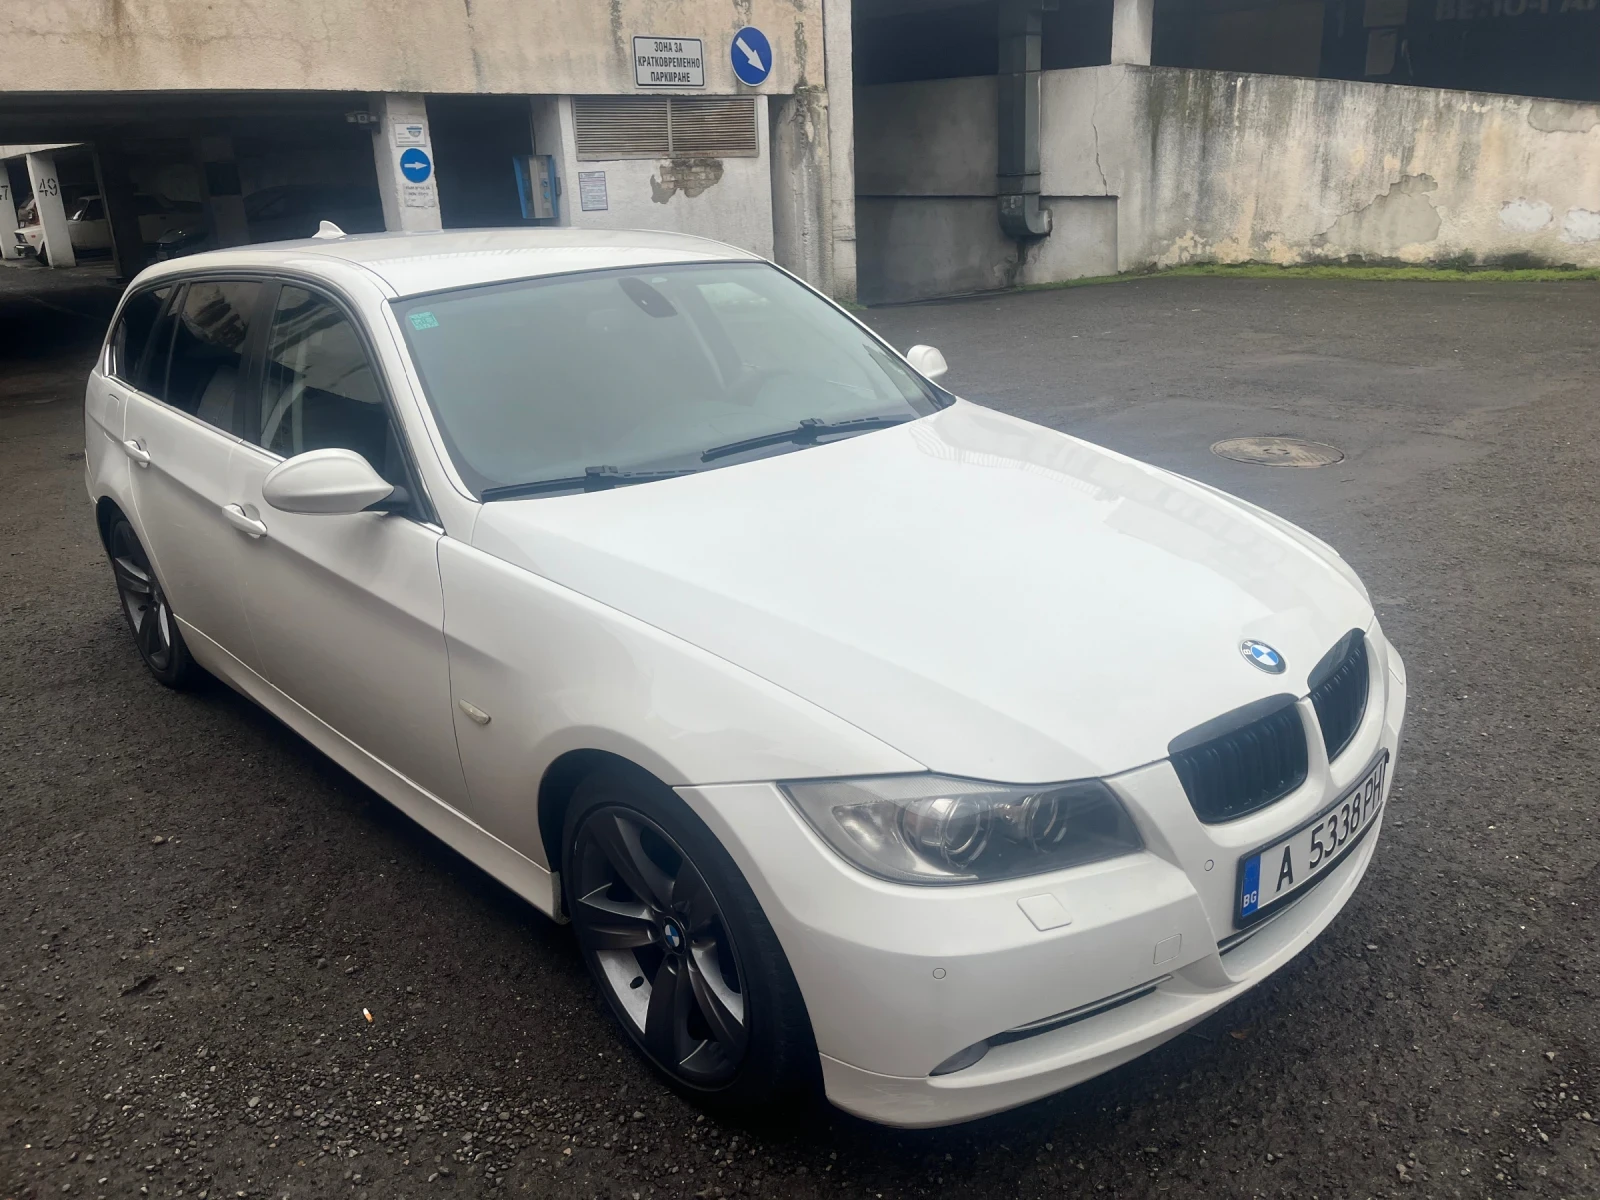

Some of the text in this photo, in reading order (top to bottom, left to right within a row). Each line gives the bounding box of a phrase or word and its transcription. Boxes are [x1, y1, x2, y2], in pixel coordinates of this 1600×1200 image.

[654, 41, 683, 53] ЗОНА ЗА
[637, 56, 701, 68] КРАТКОВРЕМЕННО
[650, 72, 691, 82] ПАРКИРАНЕ
[0, 184, 9, 201] 7
[39, 178, 58, 196] 49
[1276, 844, 1294, 892] A
[1309, 792, 1361, 869] 5338
[1243, 891, 1257, 908] BG
